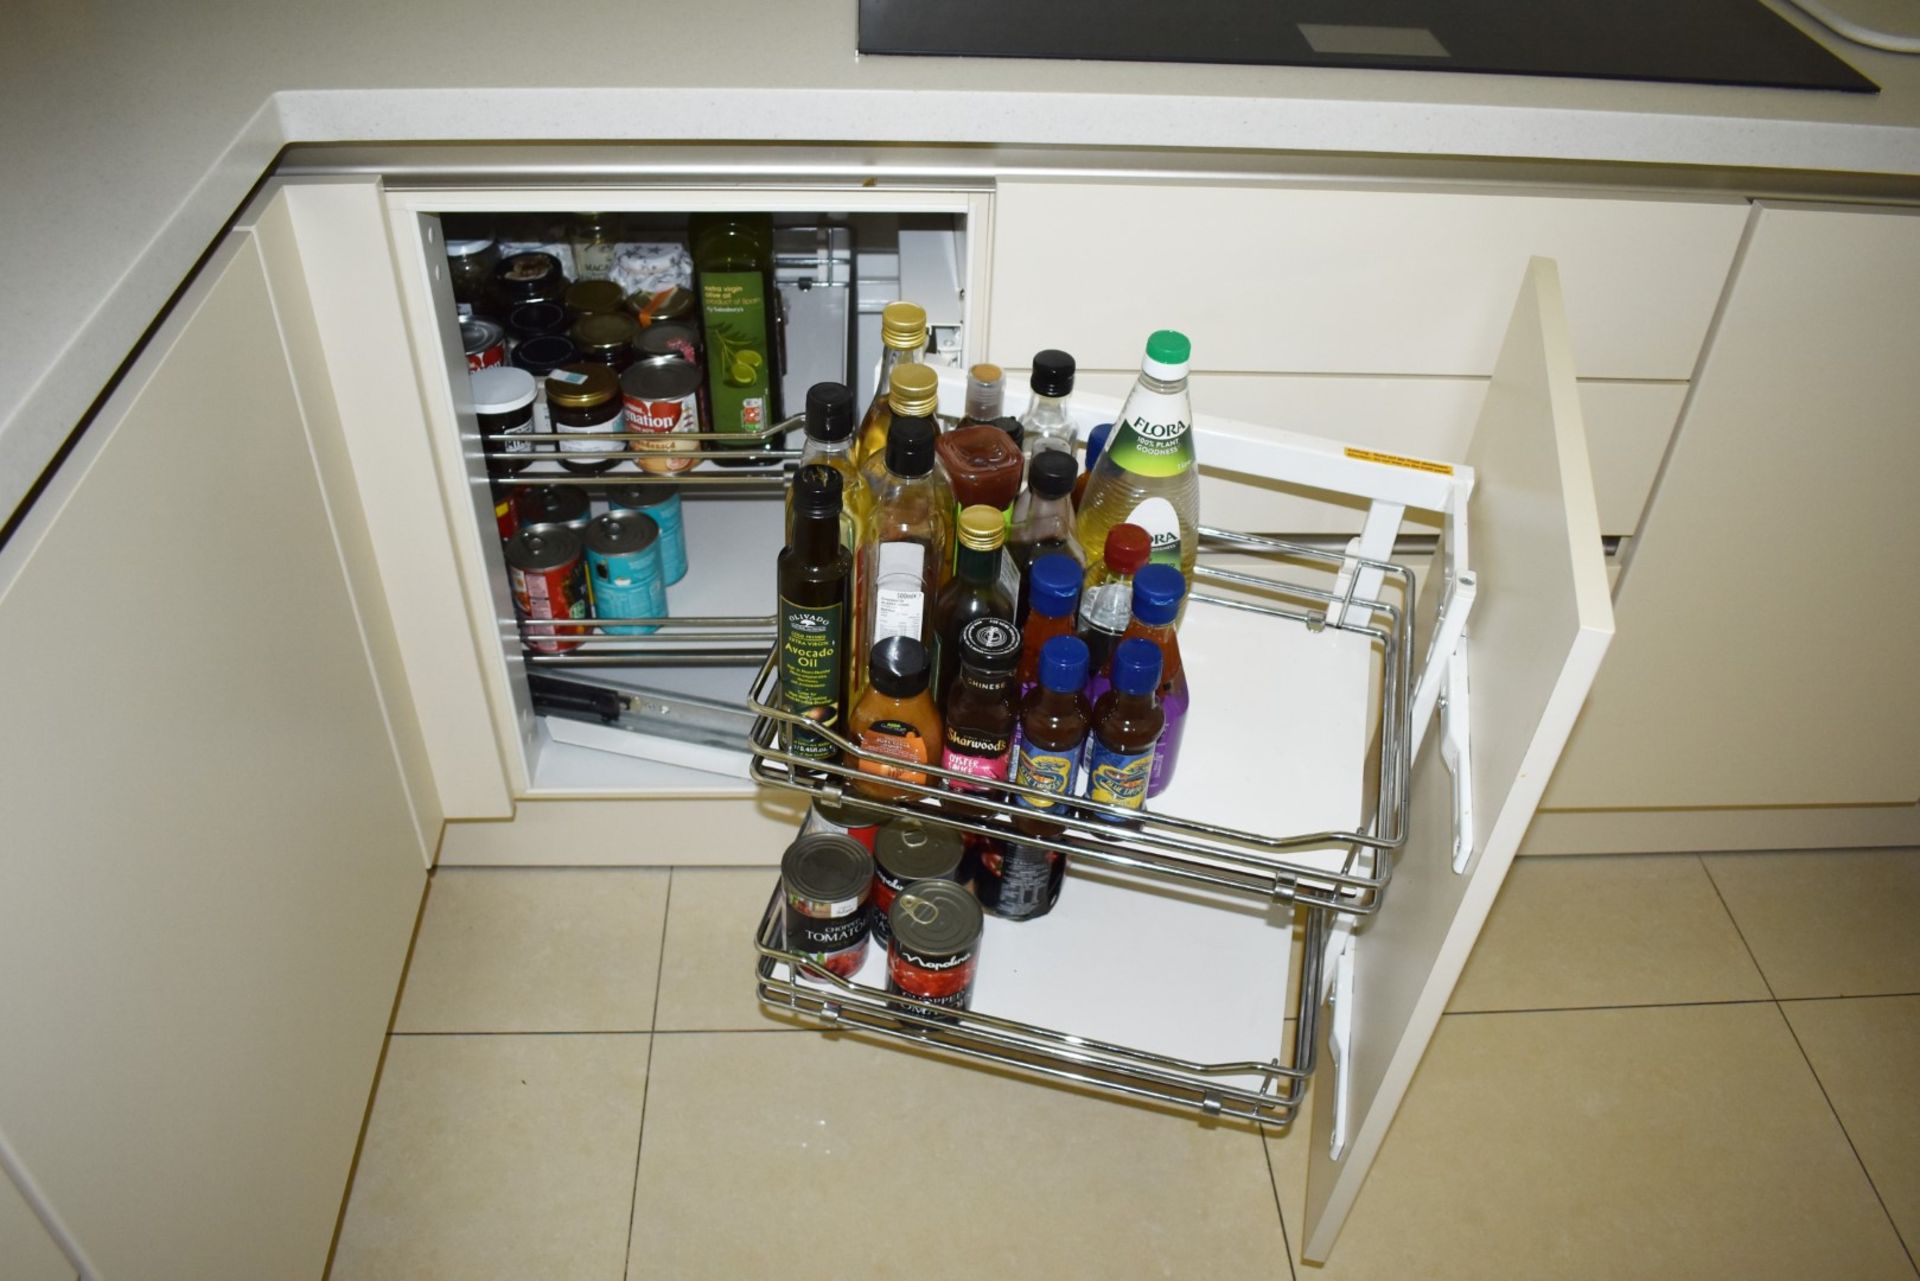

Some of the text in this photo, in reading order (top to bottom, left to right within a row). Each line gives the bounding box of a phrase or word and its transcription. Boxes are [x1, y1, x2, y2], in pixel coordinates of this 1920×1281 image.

[1133, 416, 1186, 438] FLORA
[1135, 443, 1179, 456] GOODNESS
[1137, 437, 1180, 449] 100% PLANT
[788, 613, 830, 626] OLIVADO
[784, 642, 835, 658] Avocado
[797, 656, 818, 668] Oil
[967, 677, 1006, 690] CHINESE
[947, 727, 1007, 752] Sharwood's
[948, 753, 980, 769] OYSTER
[901, 951, 971, 972] Napolina
